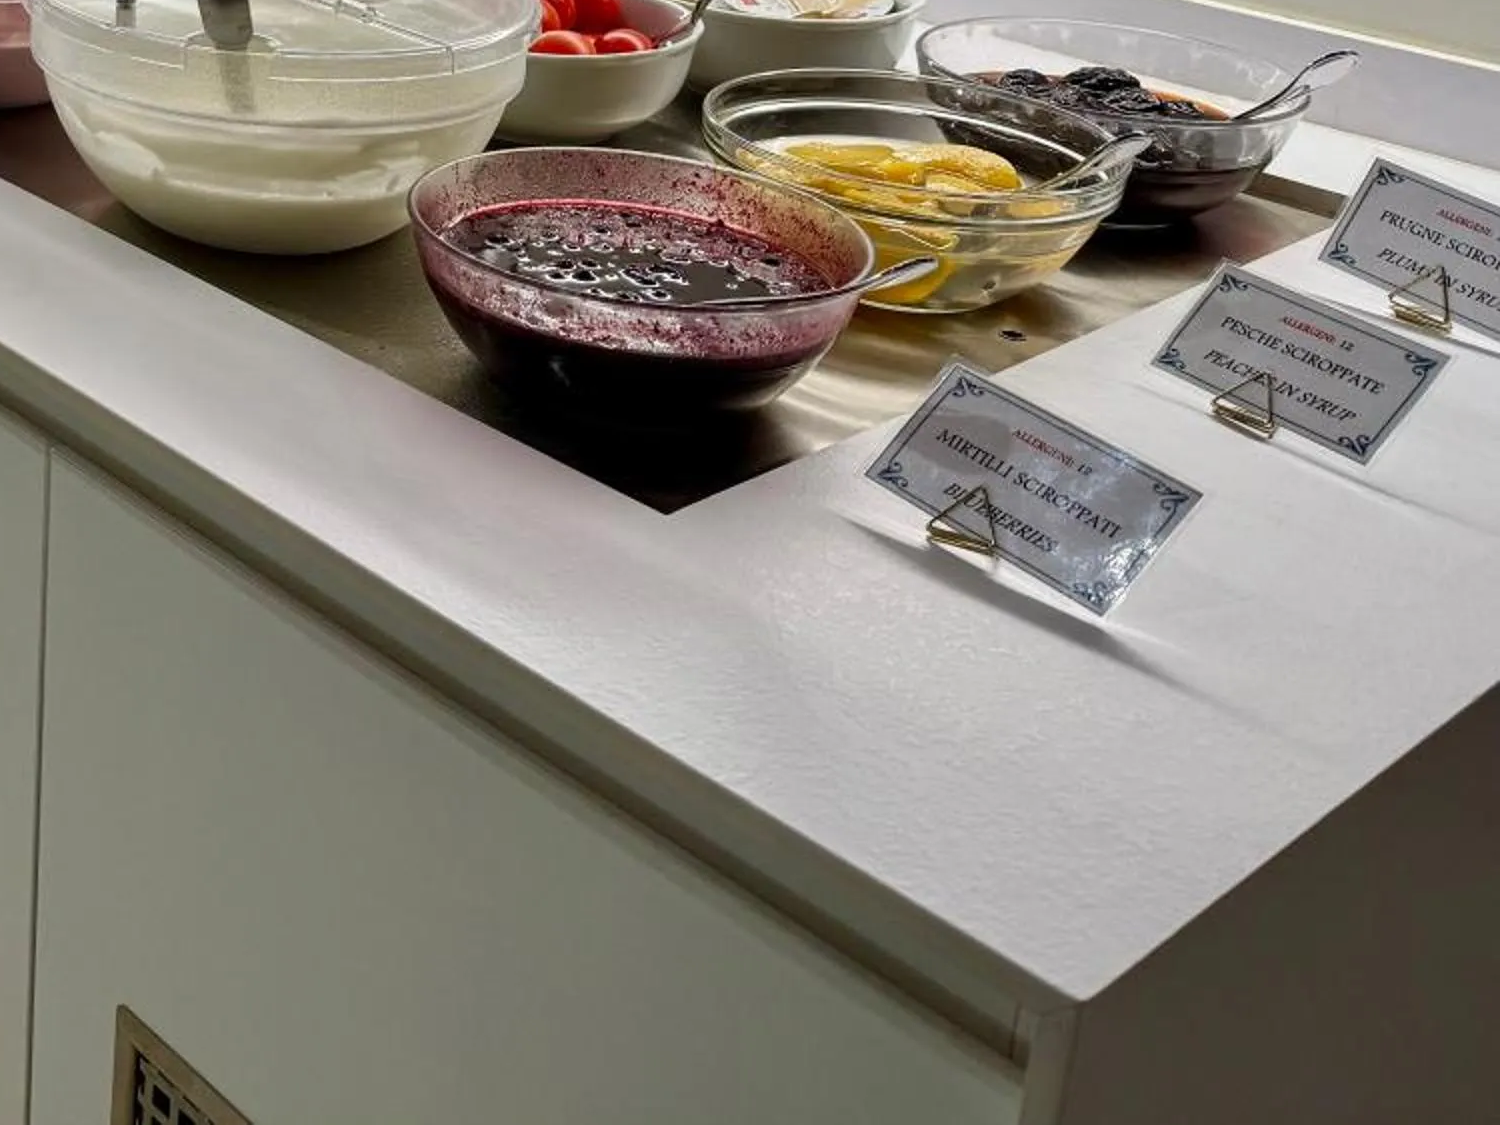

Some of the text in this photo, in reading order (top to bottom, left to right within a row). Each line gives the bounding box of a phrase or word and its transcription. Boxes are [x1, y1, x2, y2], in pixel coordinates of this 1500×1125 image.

[1380, 209, 1445, 246] PRUGNE
[1455, 282, 1500, 313] SYRU
[1220, 315, 1385, 395] PESCHE SCIROPPATE
[1275, 379, 1303, 399] IN
[1297, 391, 1357, 422] SYRUP
[935, 428, 1124, 539] MIRTILLI SCIROPPATI
